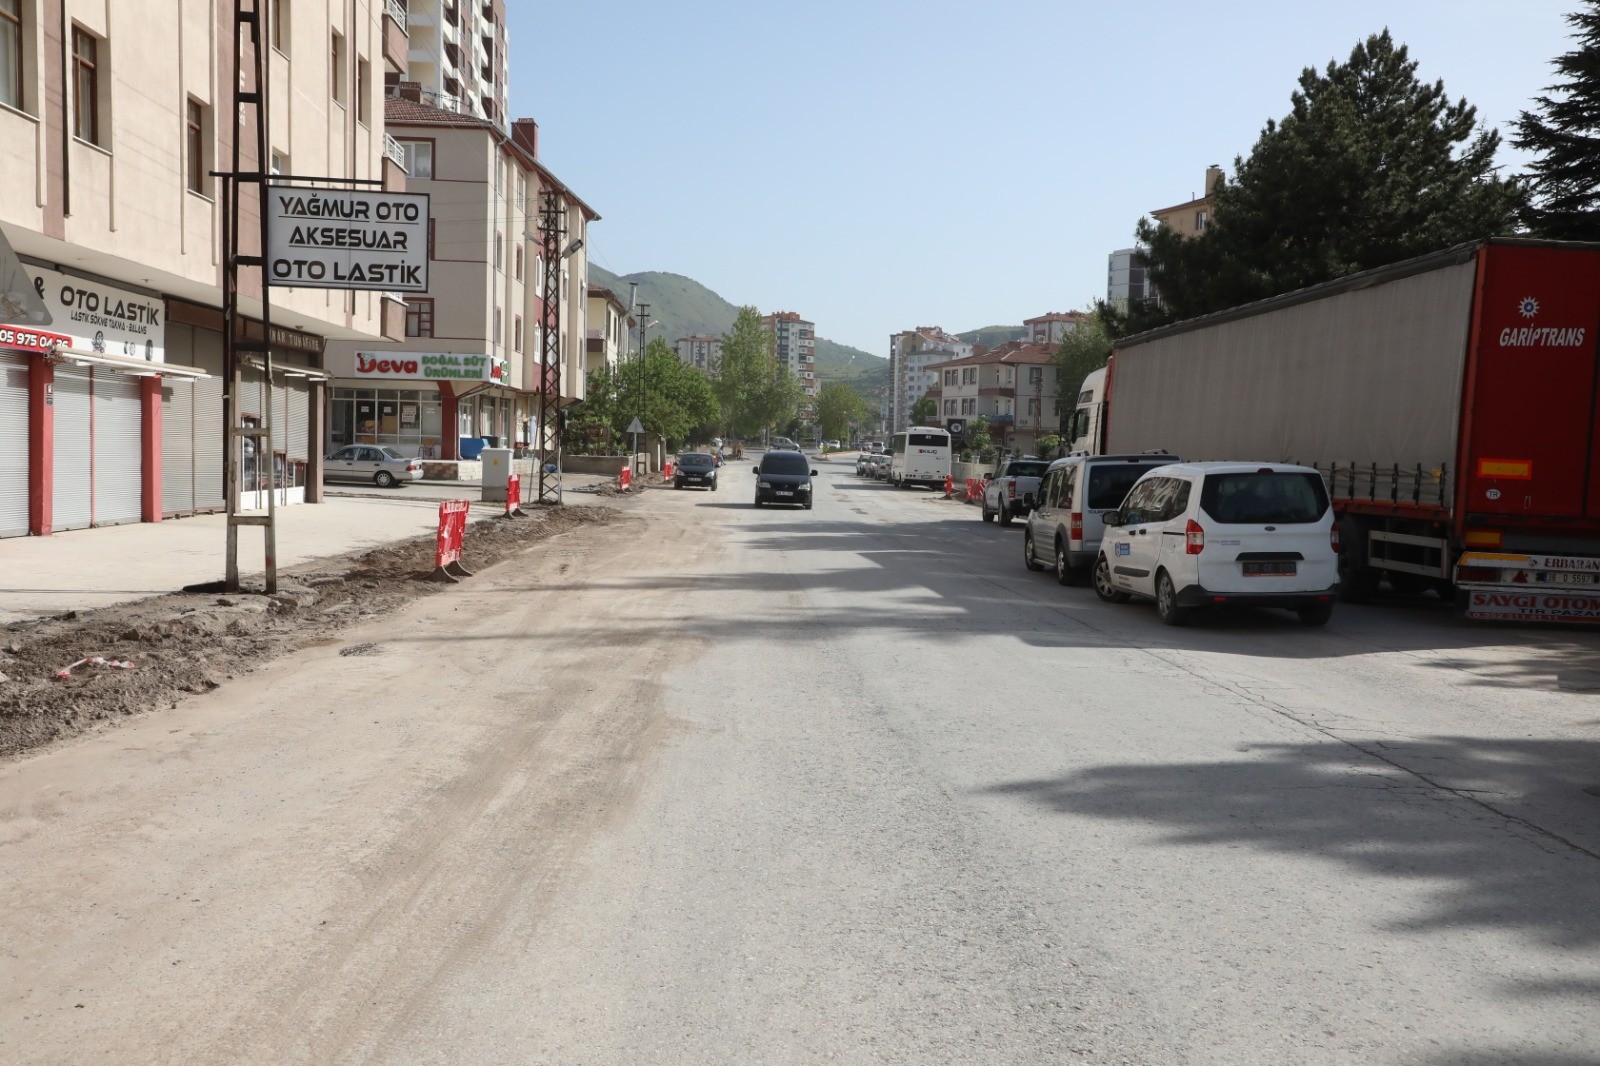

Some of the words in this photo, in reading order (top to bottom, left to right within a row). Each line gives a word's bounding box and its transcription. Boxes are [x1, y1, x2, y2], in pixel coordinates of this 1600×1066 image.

[278, 193, 370, 219] YAĞMUR
[375, 201, 419, 222] OTO
[288, 225, 408, 250] AKSESUAR
[272, 258, 326, 280] OTO
[333, 260, 422, 285] LASTİK
[60, 285, 100, 312] OTO
[103, 296, 160, 327] LASTİK
[16, 332, 38, 347] 975
[1499, 322, 1586, 347] GARİPTRANS
[357, 353, 417, 373] Deva
[421, 354, 462, 366] DOĞAL
[463, 355, 487, 366] SÜT
[424, 366, 483, 379] ÜRÜNLERİ
[1572, 574, 1591, 583] 5597
[1473, 593, 1537, 609] SAYGI
